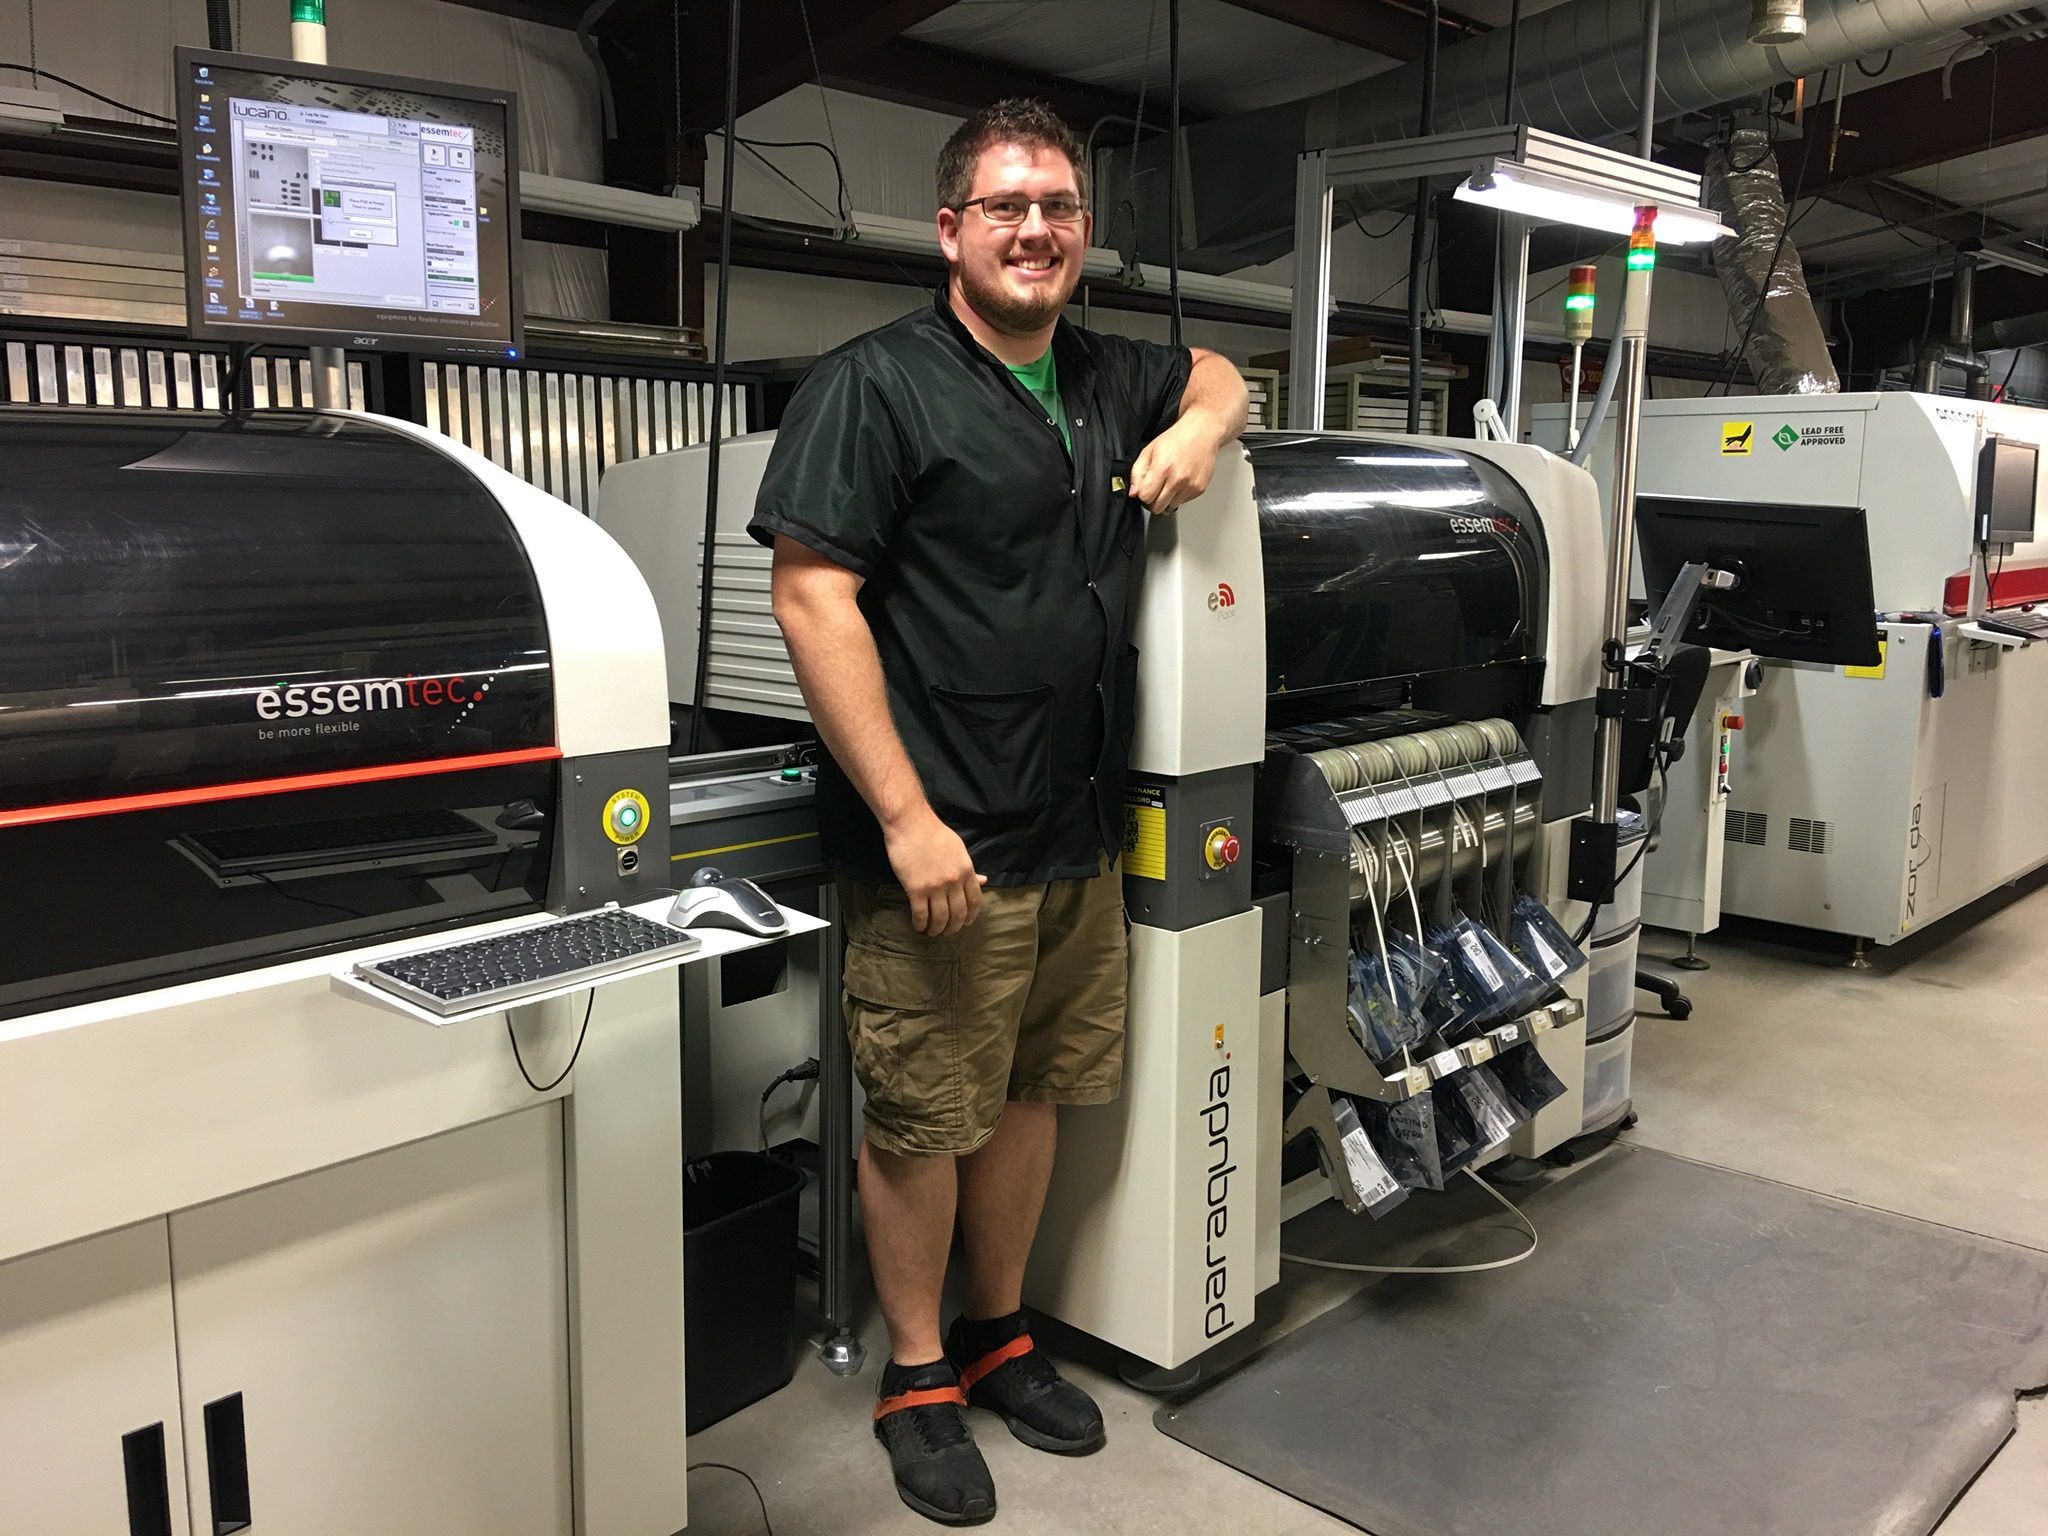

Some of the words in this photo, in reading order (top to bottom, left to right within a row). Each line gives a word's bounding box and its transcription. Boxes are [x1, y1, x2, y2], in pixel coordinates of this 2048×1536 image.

[421, 126, 464, 138] essemtec
[353, 336, 379, 346] acer
[1801, 427, 1822, 435] LEAD
[1824, 426, 1844, 434] FREE
[1801, 437, 1846, 446] APPROVED
[256, 673, 466, 720] essemtec
[258, 729, 274, 740] be
[278, 725, 311, 738] more
[315, 721, 360, 735] flexible
[611, 791, 641, 804] SYSTEM
[614, 831, 640, 842] POWER
